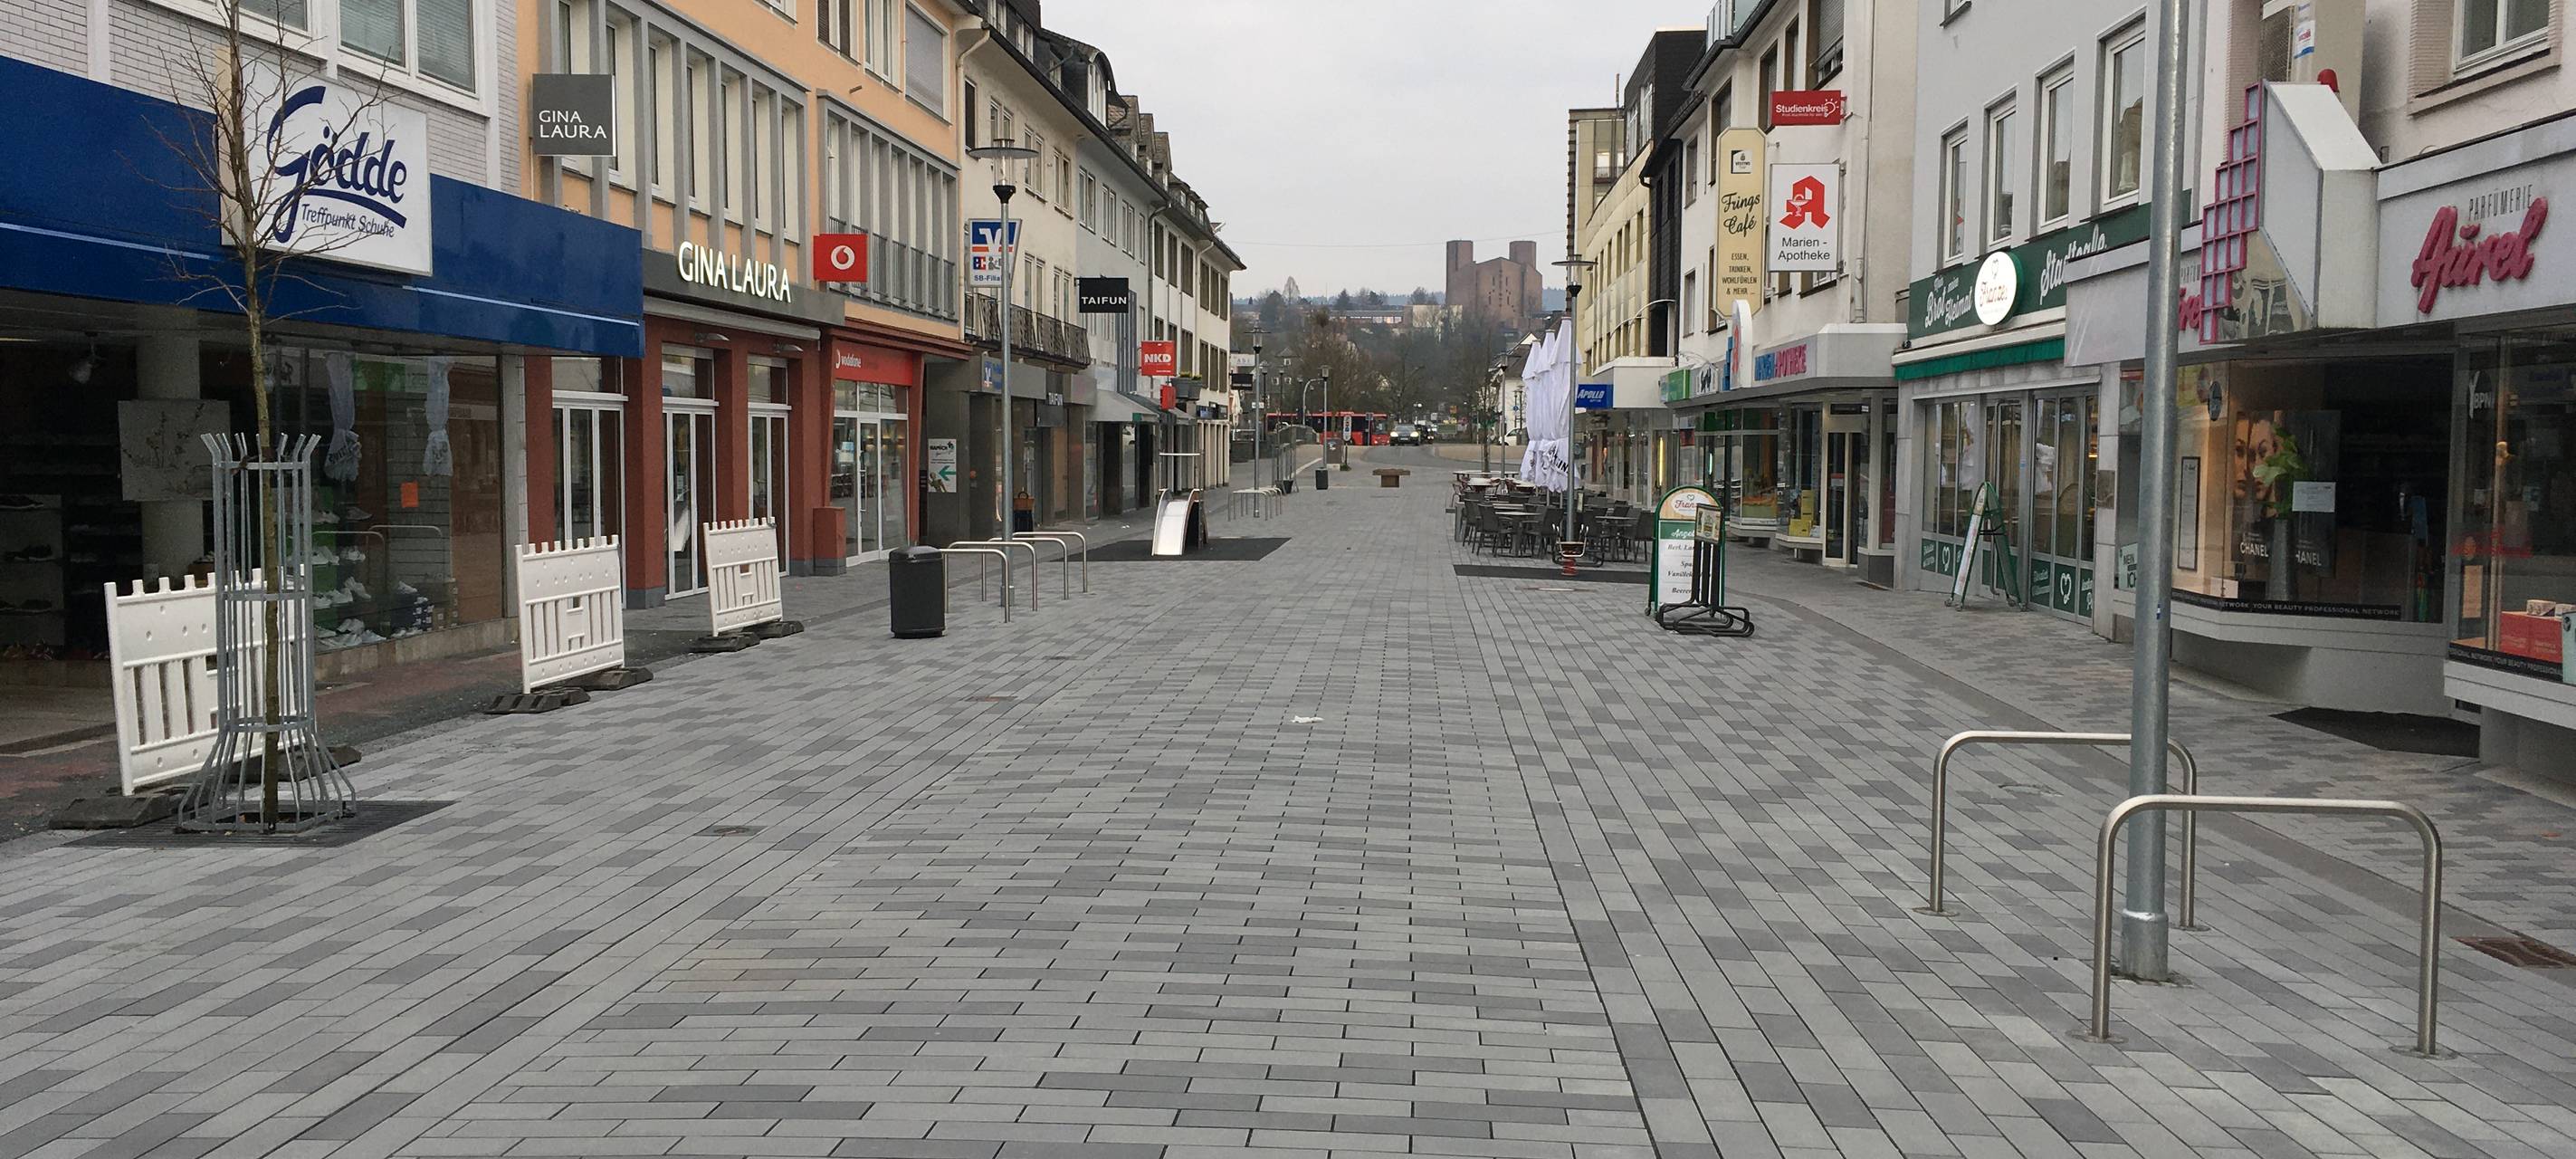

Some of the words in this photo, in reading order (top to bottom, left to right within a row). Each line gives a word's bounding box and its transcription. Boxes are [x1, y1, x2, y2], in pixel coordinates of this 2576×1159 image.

[1775, 104, 1829, 113] Studienkreis
[539, 110, 583, 123] GINA
[539, 124, 607, 139] LAURA
[266, 85, 407, 244] Gödde
[1721, 192, 1760, 213] Frings
[2468, 184, 2533, 221] PARFÜMERIE
[301, 203, 356, 230] Treffpunkt
[358, 215, 395, 238] Schuhe
[1723, 212, 1758, 237] Café
[1781, 237, 1819, 247] Marien
[1731, 253, 1749, 262] ESSEN,
[1778, 251, 1830, 263] Apotheke
[678, 241, 729, 290] GINA
[731, 254, 791, 303] LAURA
[1722, 276, 1757, 284] WOHLFÜHLEN
[1082, 296, 1127, 304] TAIFUN
[1144, 354, 1171, 363] NKD
[1578, 389, 1605, 399] APOLLO
[2239, 541, 2269, 558] CHANEL
[2295, 550, 2322, 566] HANEL
[2304, 606, 2360, 615] PROFESSIONAL
[2362, 608, 2399, 616] NETWORK
